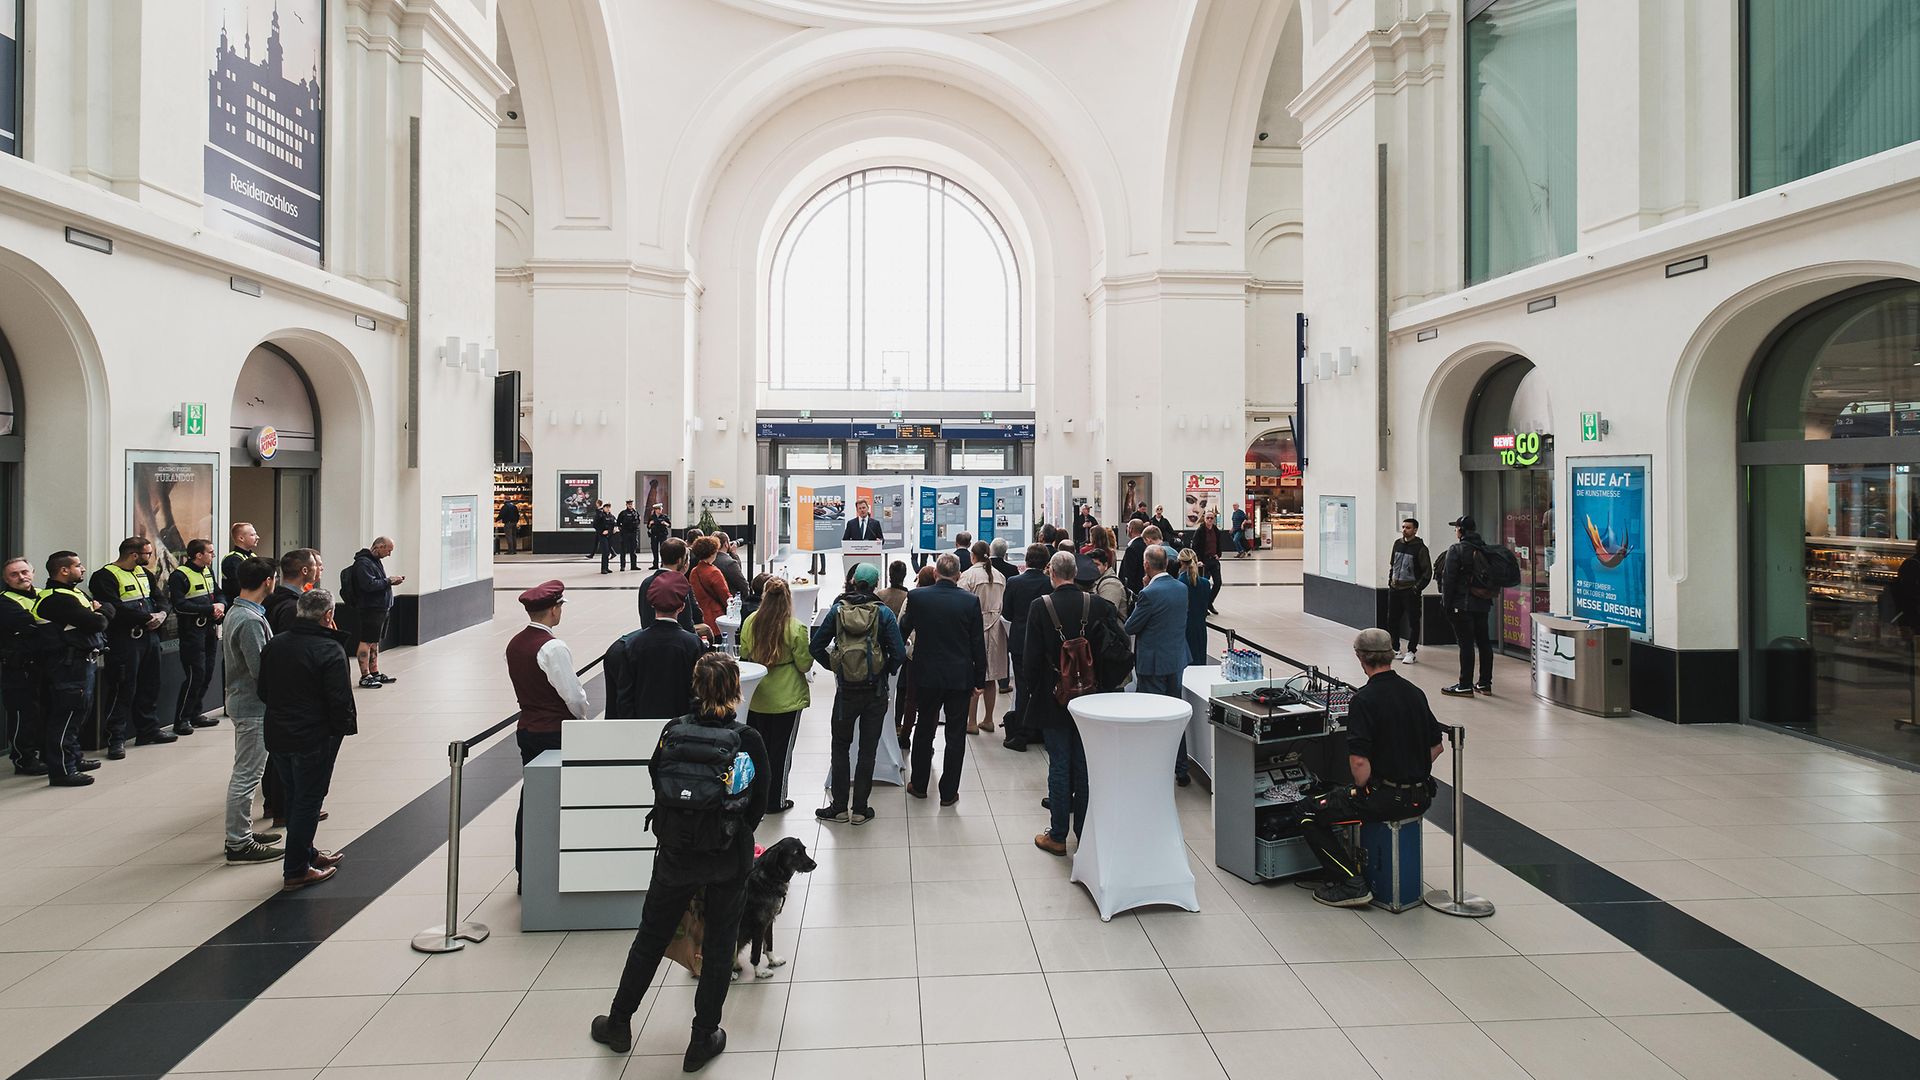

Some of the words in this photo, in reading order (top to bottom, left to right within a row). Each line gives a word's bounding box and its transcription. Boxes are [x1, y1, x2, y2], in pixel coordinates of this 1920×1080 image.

[230, 173, 298, 217] Residenzschloss
[260, 431, 276, 444] BURGER
[261, 437, 277, 451] KING
[1493, 436, 1514, 447] REWE
[1516, 432, 1539, 454] GO
[1500, 450, 1515, 465] TO
[154, 473, 195, 482] TURANDOT
[1576, 473, 1606, 487] NEUE
[1608, 473, 1631, 487] ArT
[799, 495, 842, 504] HINTER
[1576, 489, 1584, 497] DIE
[1585, 490, 1621, 498] KUNSTMESSE
[1583, 581, 1611, 591] SEPTEMBER
[1583, 589, 1605, 599] OKTOBER
[1576, 597, 1602, 611] MESSE
[1603, 602, 1642, 619] DRESDEN
